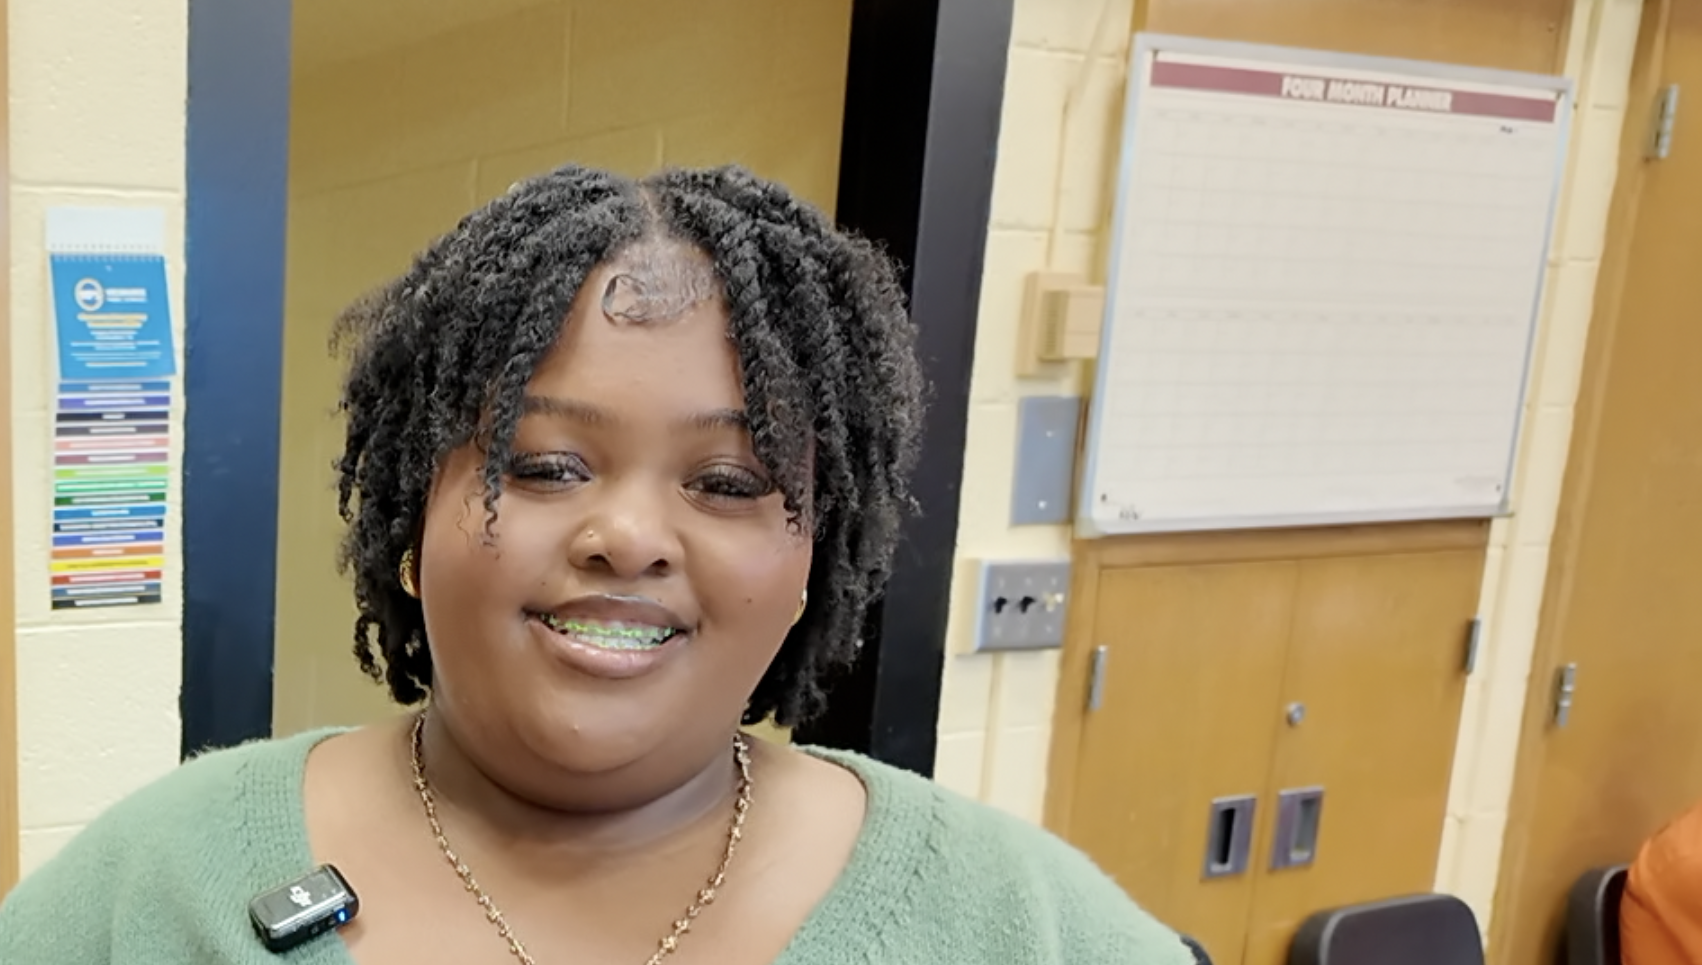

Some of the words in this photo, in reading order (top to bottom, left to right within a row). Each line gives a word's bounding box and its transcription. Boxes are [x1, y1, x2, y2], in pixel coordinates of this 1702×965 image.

[1282, 75, 1326, 100] FOUR
[1328, 79, 1385, 106] MONTH
[1387, 85, 1453, 112] PLANNER
